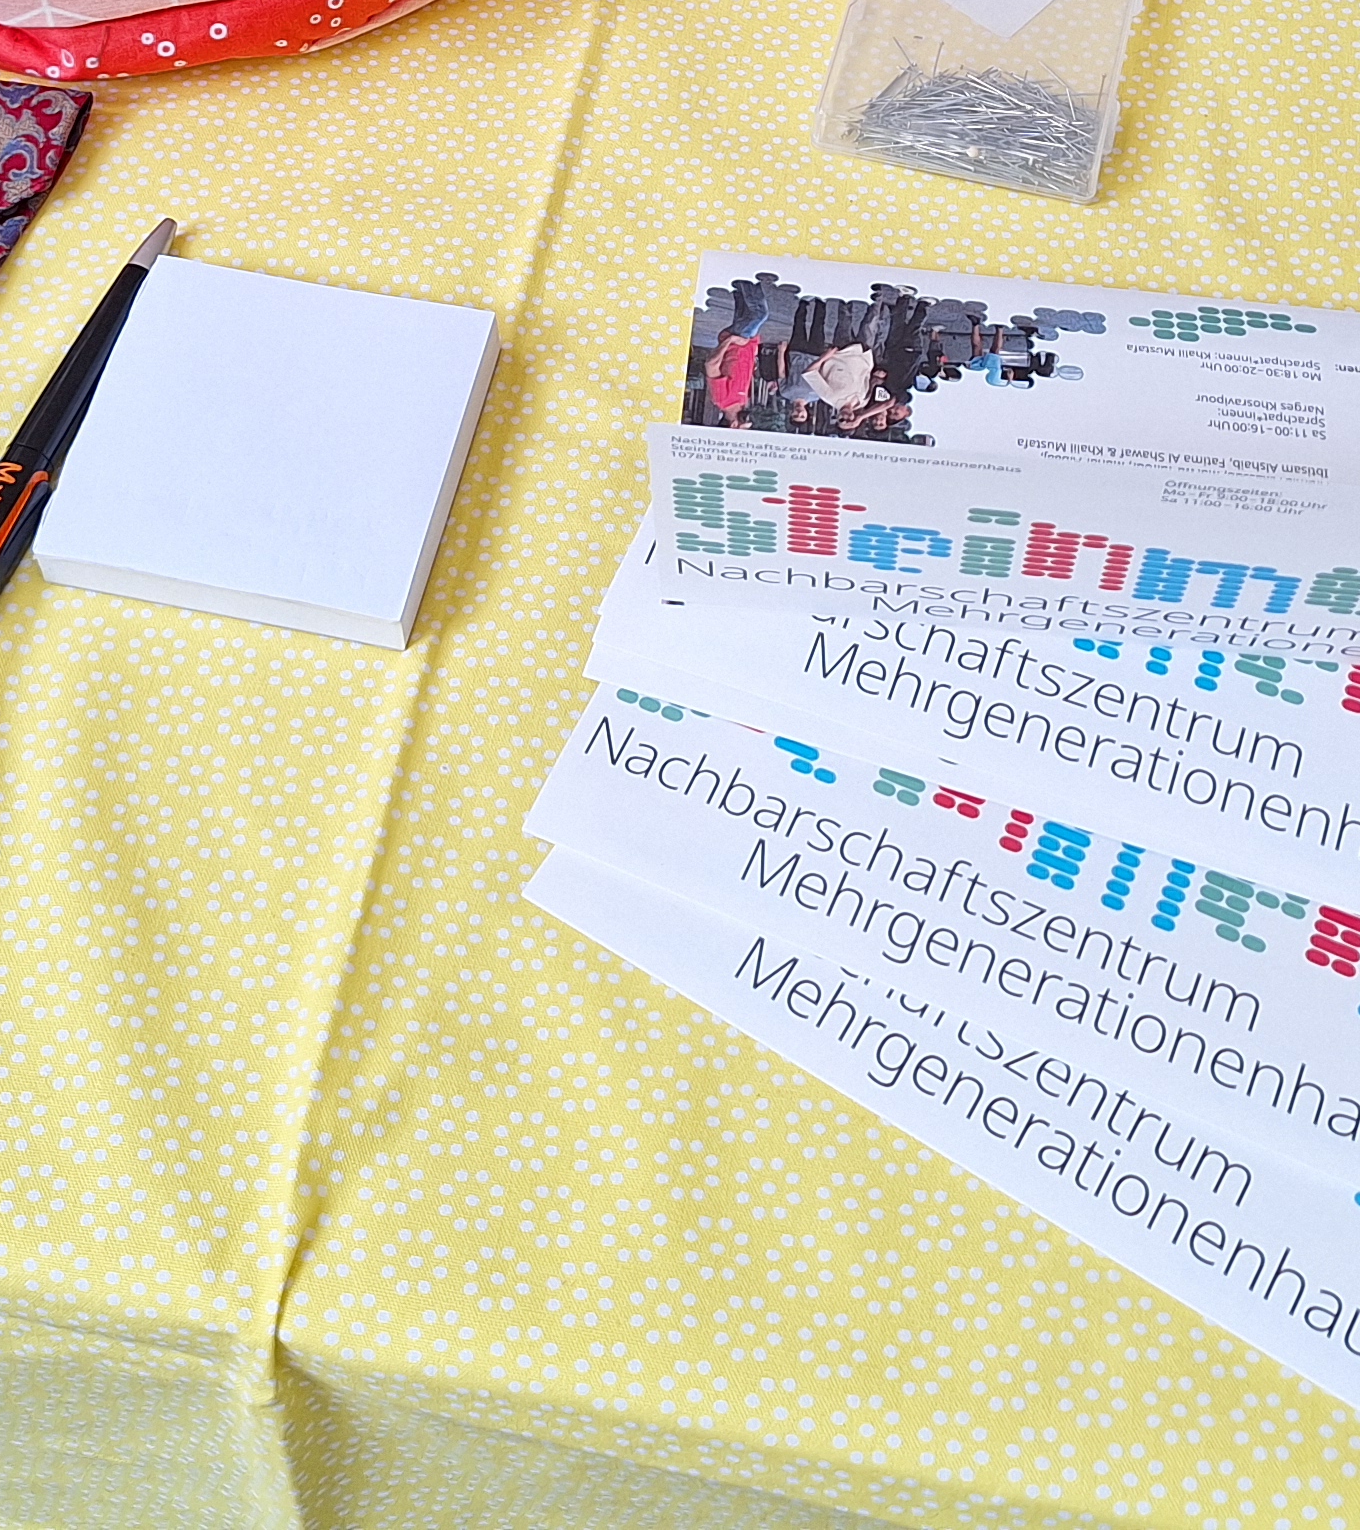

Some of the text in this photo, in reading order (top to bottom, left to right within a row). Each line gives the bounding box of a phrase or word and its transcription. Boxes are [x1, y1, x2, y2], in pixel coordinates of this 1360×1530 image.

[1126, 343, 1176, 358] Mustafa
[1199, 360, 1223, 373] Uhr
[1302, 372, 1322, 382] Mo
[1279, 401, 1325, 416] Narges
[1206, 418, 1232, 431] Uhr
[1312, 430, 1327, 440] Sa
[1016, 437, 1067, 453] Mustafa
[583, 714, 1264, 1033] Nachbarschaftszentrum
